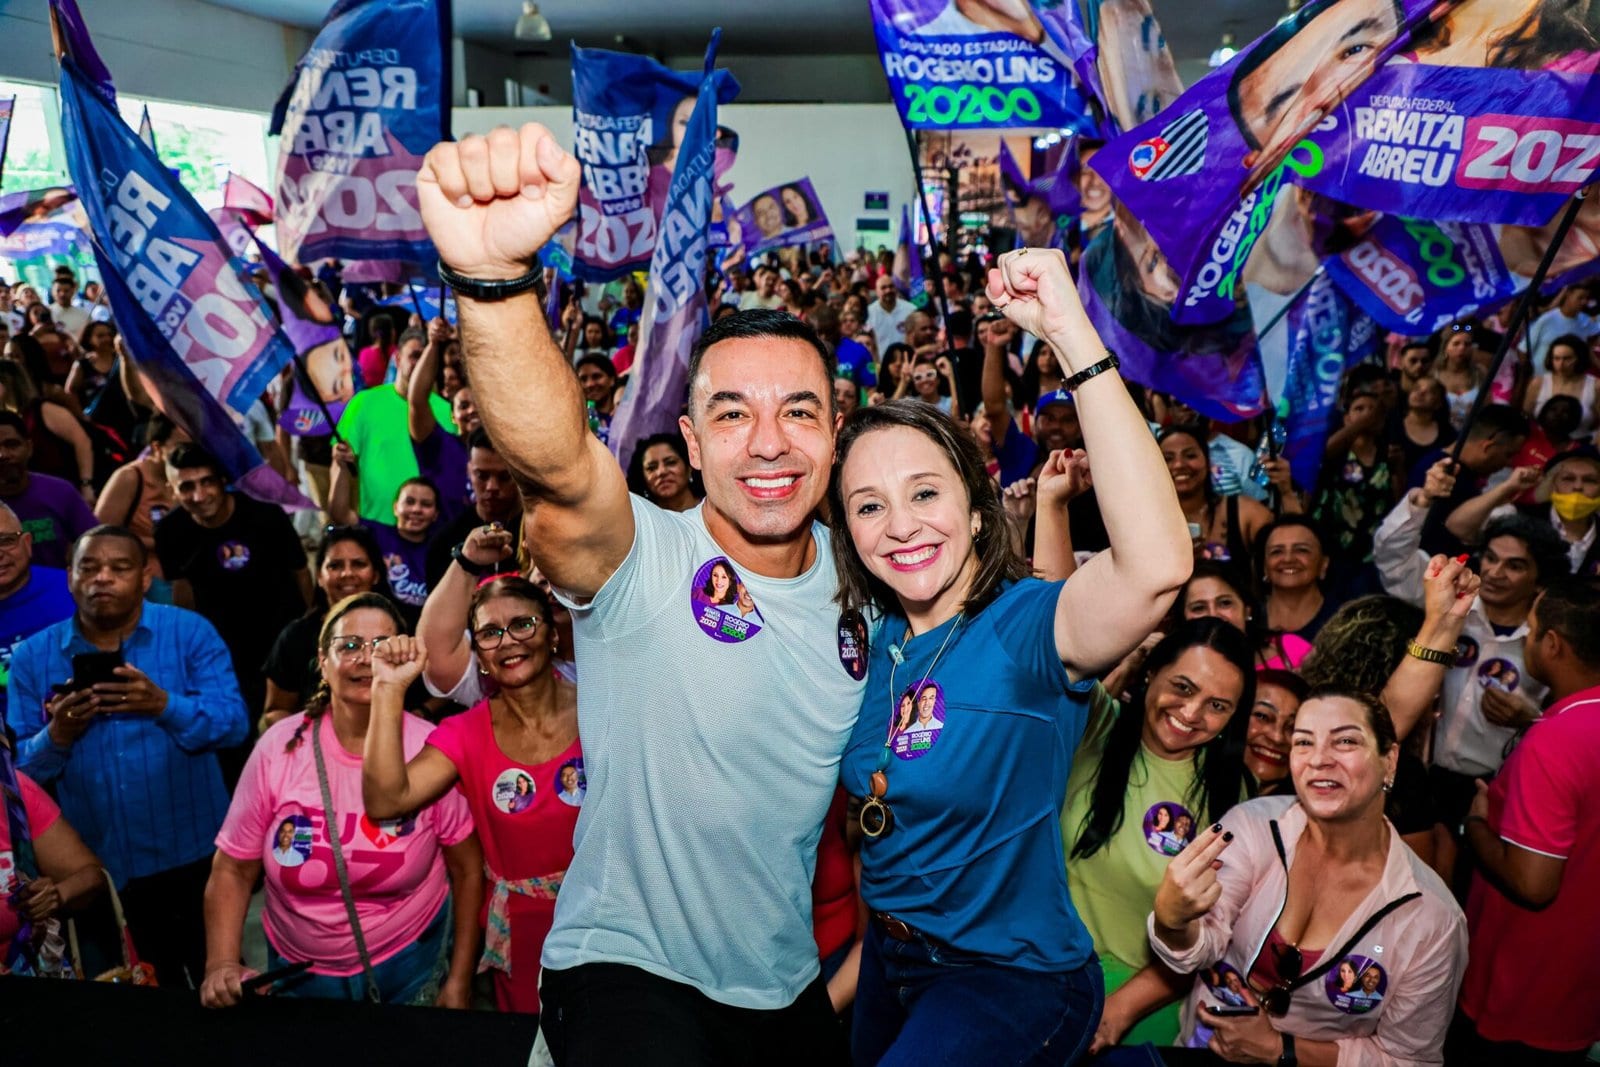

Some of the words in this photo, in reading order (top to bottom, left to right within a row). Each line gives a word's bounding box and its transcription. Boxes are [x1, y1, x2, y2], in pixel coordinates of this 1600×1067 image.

[964, 40, 1036, 56] ESTADUAL
[995, 56, 1056, 83] LINS
[904, 84, 1041, 124] 20200
[1411, 98, 1456, 113] FEDERAL
[1355, 107, 1465, 150] RENATA
[1358, 143, 1456, 187] ABREU
